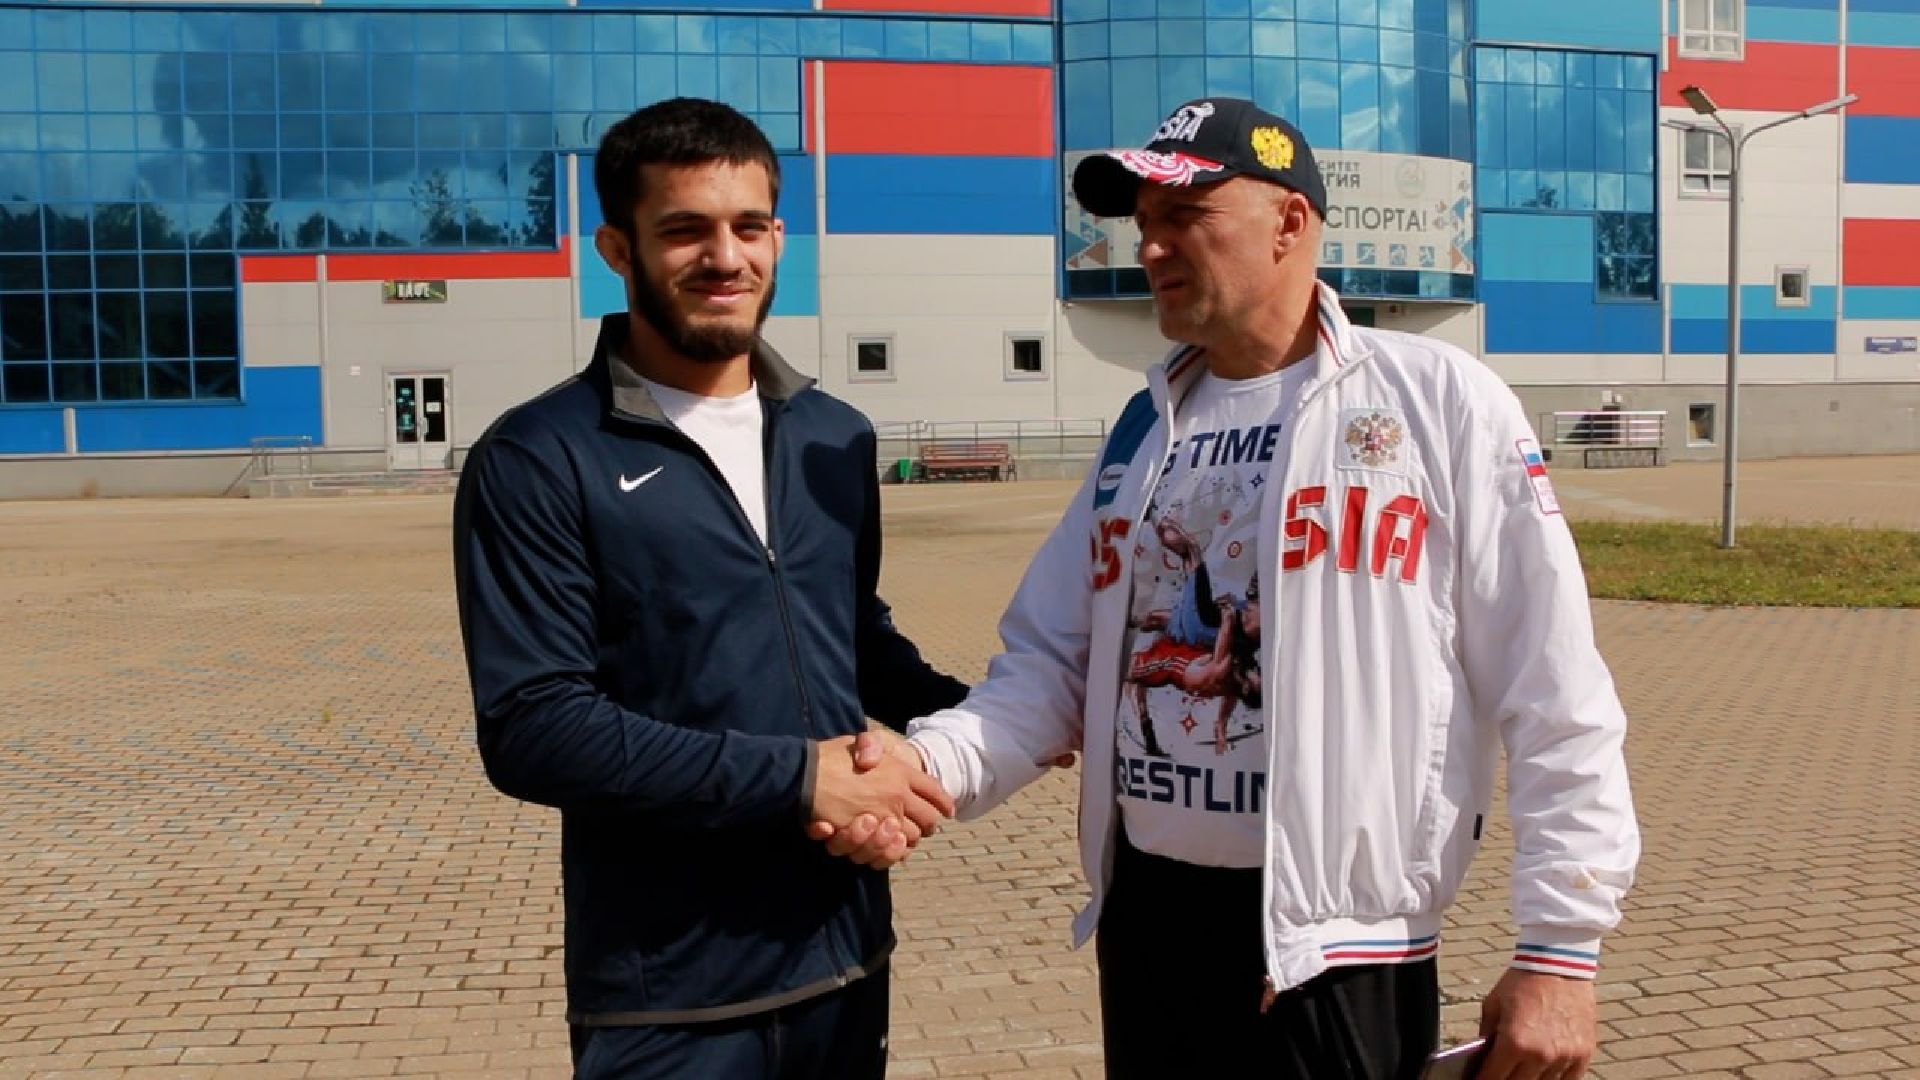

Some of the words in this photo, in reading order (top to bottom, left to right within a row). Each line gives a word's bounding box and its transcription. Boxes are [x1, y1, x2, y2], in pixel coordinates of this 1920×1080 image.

[1326, 205, 1427, 232] СПОРТА!
[1191, 423, 1282, 468] TIME
[1283, 486, 1428, 584] SIA
